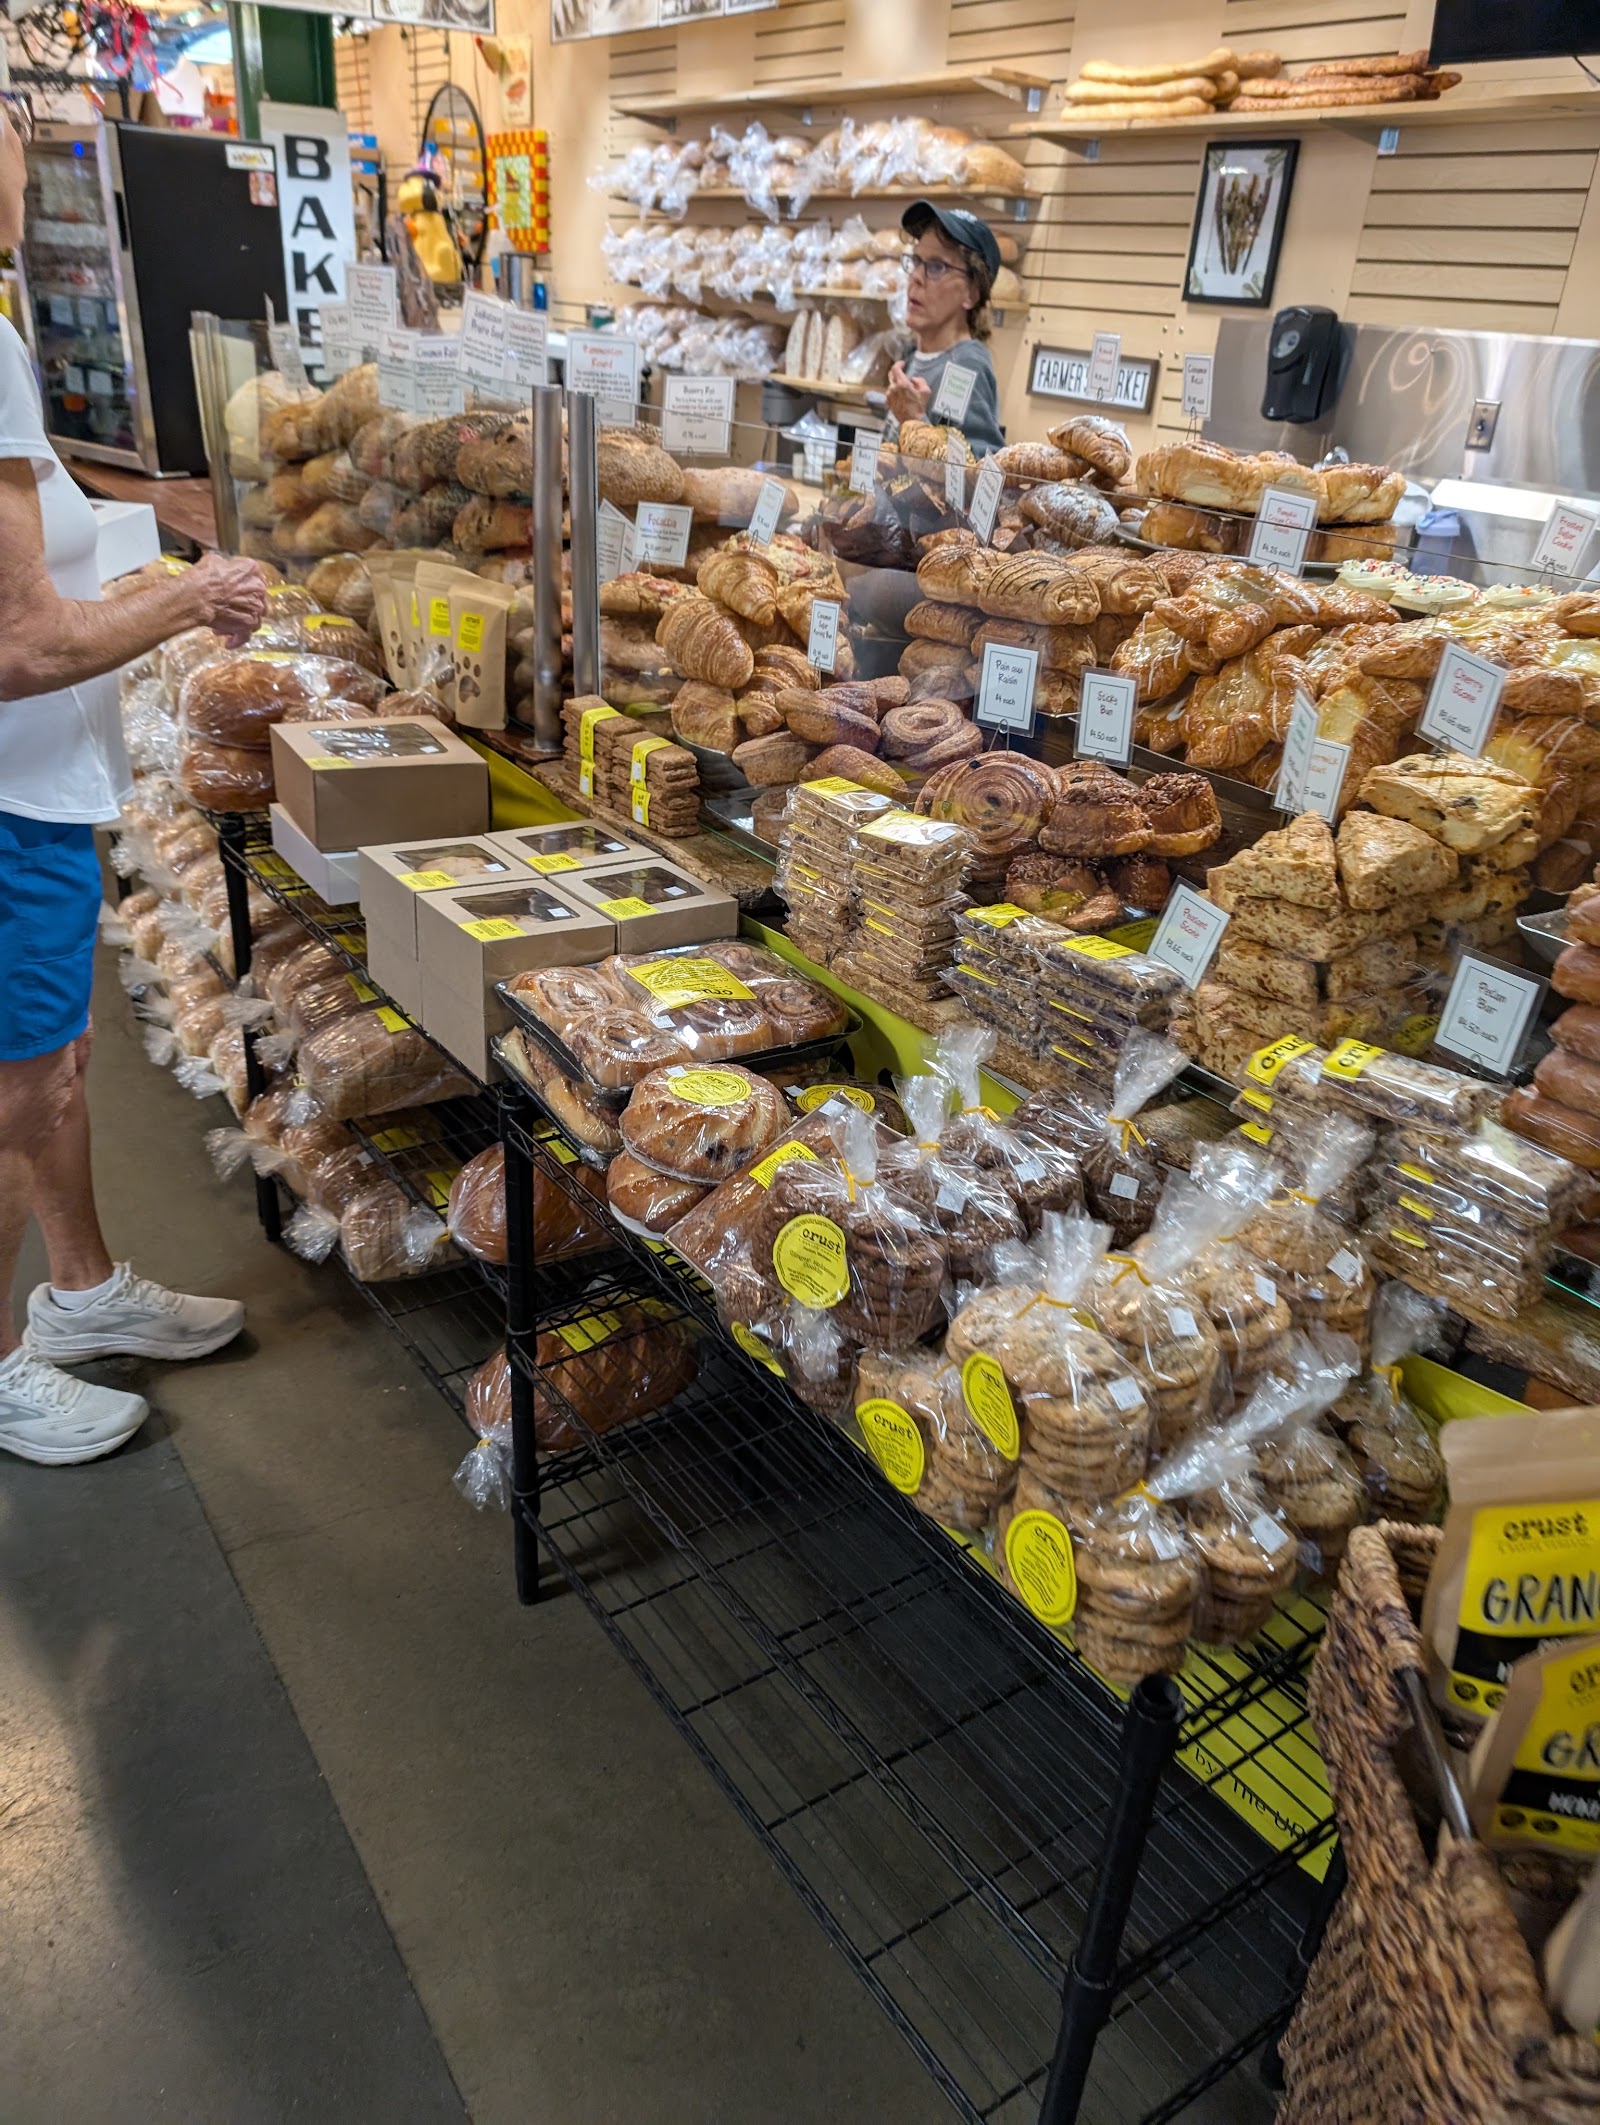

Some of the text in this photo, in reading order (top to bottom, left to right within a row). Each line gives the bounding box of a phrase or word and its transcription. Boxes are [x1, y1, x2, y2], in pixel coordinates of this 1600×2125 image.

[1560, 516, 1584, 532] Frosted
[1552, 536, 1573, 551] Cookie
[1278, 549, 1291, 557] each
[995, 659, 1024, 675] Pain aux
[997, 673, 1018, 685] Raisin
[1453, 667, 1484, 693] Cherry
[1097, 690, 1118, 706] Sticky
[1451, 682, 1477, 704] Scone
[1003, 697, 1016, 706] each
[1099, 705, 1113, 716] Bun
[1089, 728, 1118, 743] $4.50 each
[1310, 789, 1327, 800] each
[1180, 920, 1200, 939] Scone
[1181, 951, 1194, 963] each
[1476, 997, 1498, 1014] Bar
[1261, 1037, 1309, 1070] crus
[1338, 1042, 1372, 1067] cru
[706, 1075, 737, 1091] crust
[802, 1228, 841, 1255] crust
[873, 1413, 913, 1439] crust
[1503, 1511, 1589, 1542] crust
[1481, 1569, 1600, 1625] GRAN
